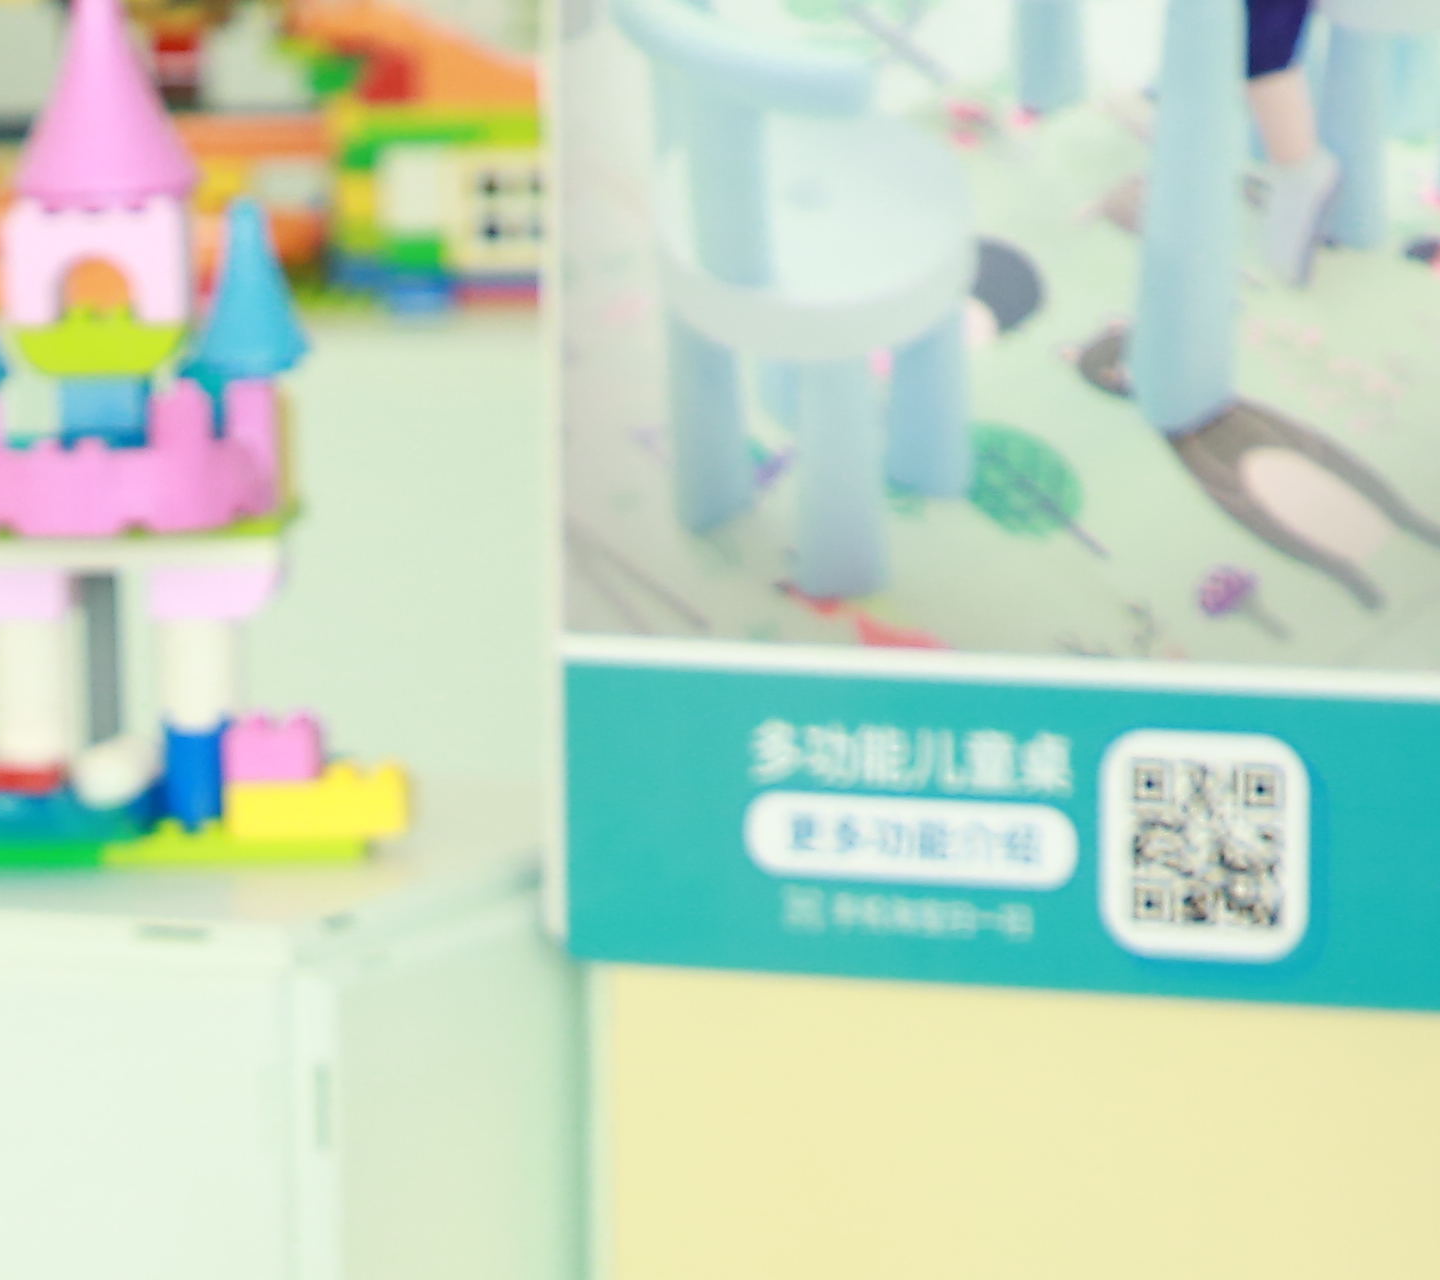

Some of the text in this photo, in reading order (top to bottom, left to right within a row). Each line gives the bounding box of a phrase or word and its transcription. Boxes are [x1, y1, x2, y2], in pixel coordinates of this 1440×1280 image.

[748, 719, 1073, 796] 多功能儿童桌
